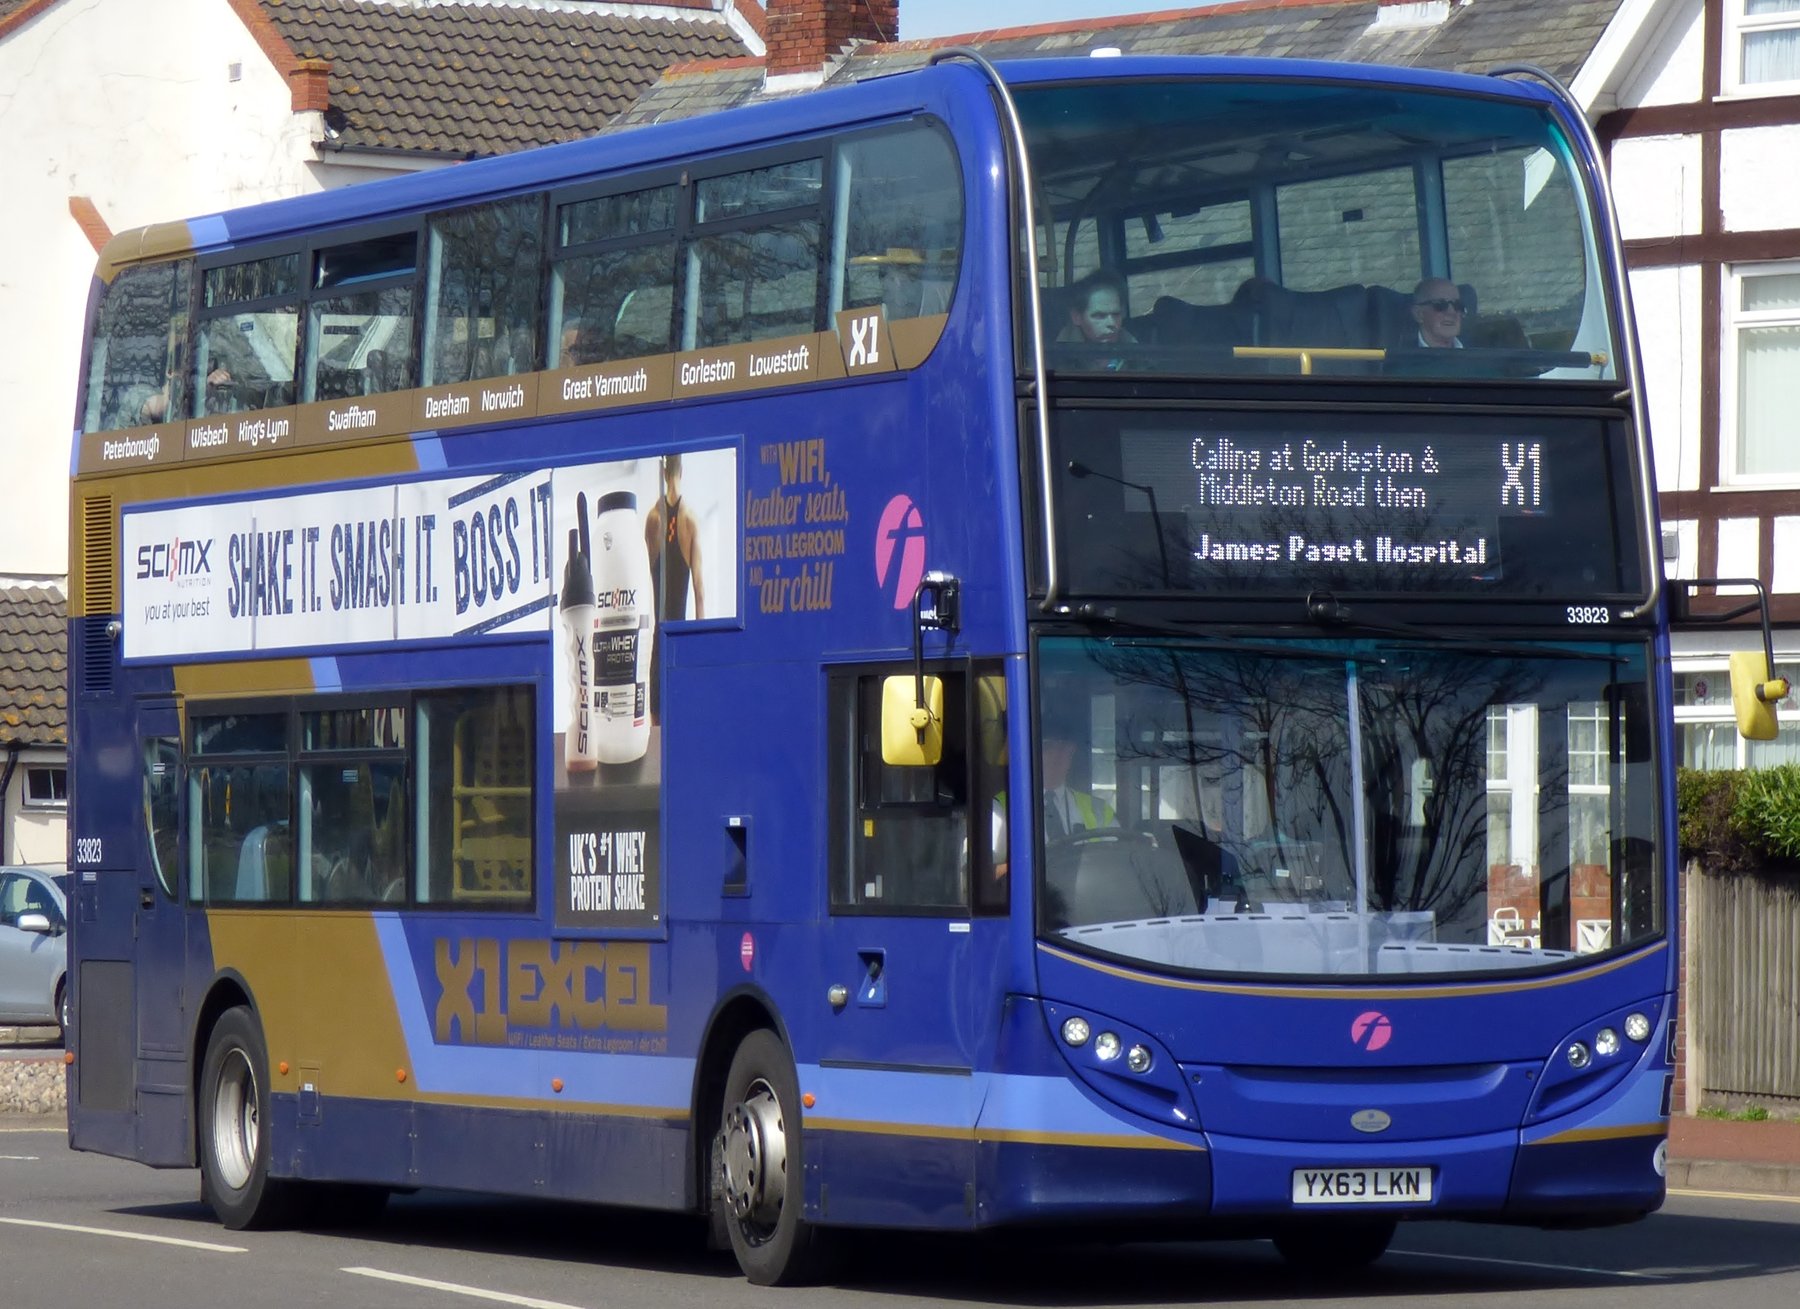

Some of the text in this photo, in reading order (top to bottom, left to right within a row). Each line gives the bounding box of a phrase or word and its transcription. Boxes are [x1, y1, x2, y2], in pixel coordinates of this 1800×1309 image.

[850, 315, 878, 367] X1
[681, 345, 809, 386] Gorleston Lowestoft
[563, 367, 647, 400] Great Yarmouth
[328, 405, 377, 431] Swaffham
[425, 384, 524, 419] Dereham Norwich
[103, 433, 160, 460] Peterborough
[191, 418, 289, 448] Wisbech King's Lynn
[778, 438, 831, 488] WIFI,
[1192, 438, 1440, 474] Calling at Gorleston &
[1200, 473, 1427, 508] Middleton Road then
[1502, 443, 1540, 506] X1
[745, 482, 849, 528] leather seats,
[228, 529, 293, 618] SHAKE
[301, 526, 322, 613] IT.
[330, 517, 406, 611] SMASH
[415, 514, 438, 603] IT.
[454, 496, 521, 616] BOSS
[745, 529, 845, 561] EXTRA LEGROOM
[1193, 534, 1486, 564] James Paget Hospital
[761, 564, 790, 613] air
[790, 561, 834, 611] chill
[145, 597, 211, 624] you at your best
[1566, 606, 1610, 624] 33823
[611, 635, 637, 652] WHEY
[77, 838, 102, 864] 33823
[570, 831, 646, 874] UK'S #1 WHEY
[570, 874, 645, 911] PROTEIN SHAKE
[557, 1035, 577, 1049] Seats
[1304, 1171, 1420, 1197] YX63 LKN
